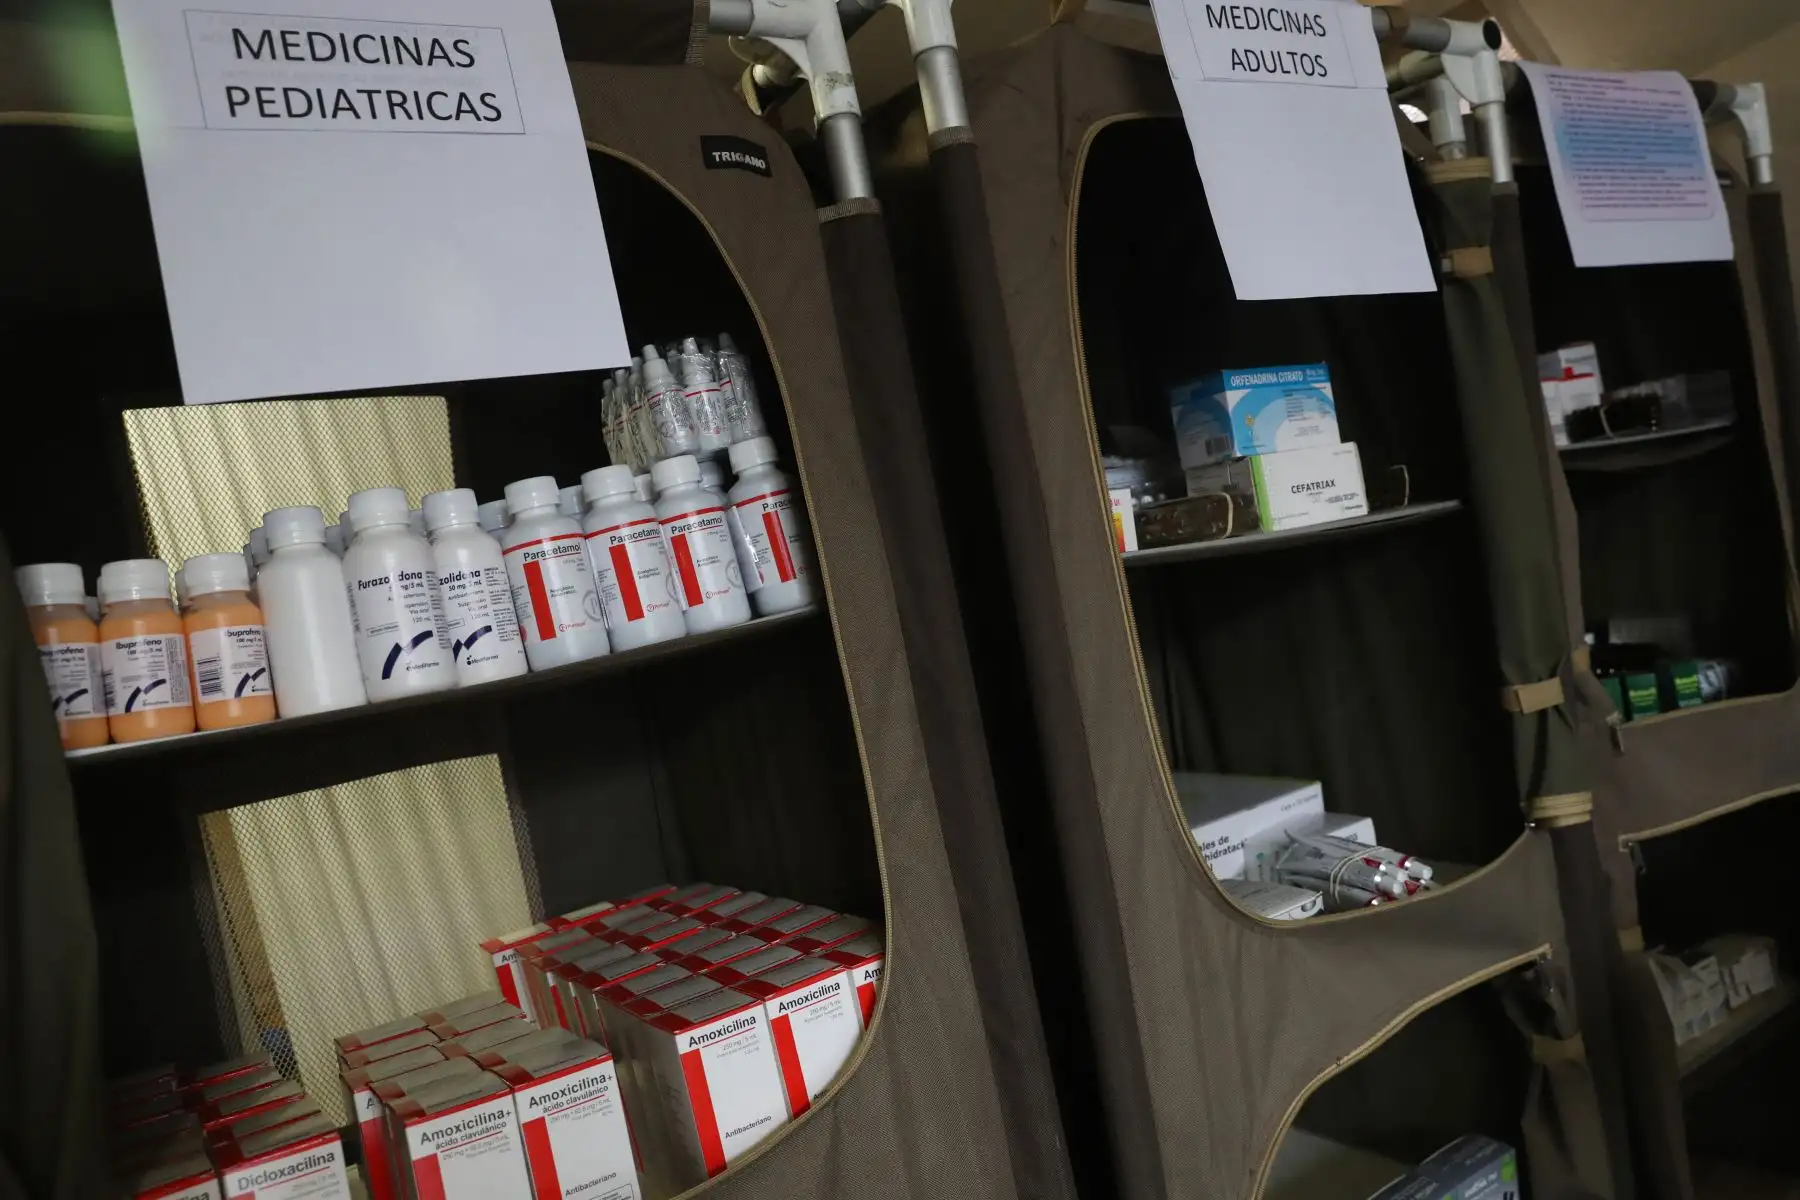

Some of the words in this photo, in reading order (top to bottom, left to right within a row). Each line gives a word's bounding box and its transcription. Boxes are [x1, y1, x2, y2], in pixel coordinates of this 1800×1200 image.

[1205, 4, 1327, 38] MEDICINAS
[231, 28, 475, 69] MEDICINAS
[1230, 48, 1328, 78] ADULTOS
[225, 85, 502, 122] PEDIATRICAS
[712, 151, 766, 169] TRIGANO
[1231, 373, 1277, 386] ORFENADRINA
[1278, 371, 1303, 383] CITRATO
[1291, 479, 1336, 493] CEFATRIAX
[358, 571, 422, 590] Furazodona
[116, 639, 162, 649] Ibuprfeno
[1200, 840, 1216, 851] les
[1218, 836, 1230, 845] de
[779, 982, 841, 1013] Amoxicilina
[689, 1016, 756, 1047] Amoxicilina
[529, 1074, 612, 1109] Amoxicilina+
[566, 1086, 608, 1105] clavulánico
[421, 1109, 512, 1145] Amoxicilina+
[460, 1121, 507, 1141] clavulánico
[725, 1115, 772, 1138] Antibacteriano
[238, 1151, 335, 1191] Dicloxacilina
[566, 1172, 617, 1196] Antibacteriano
